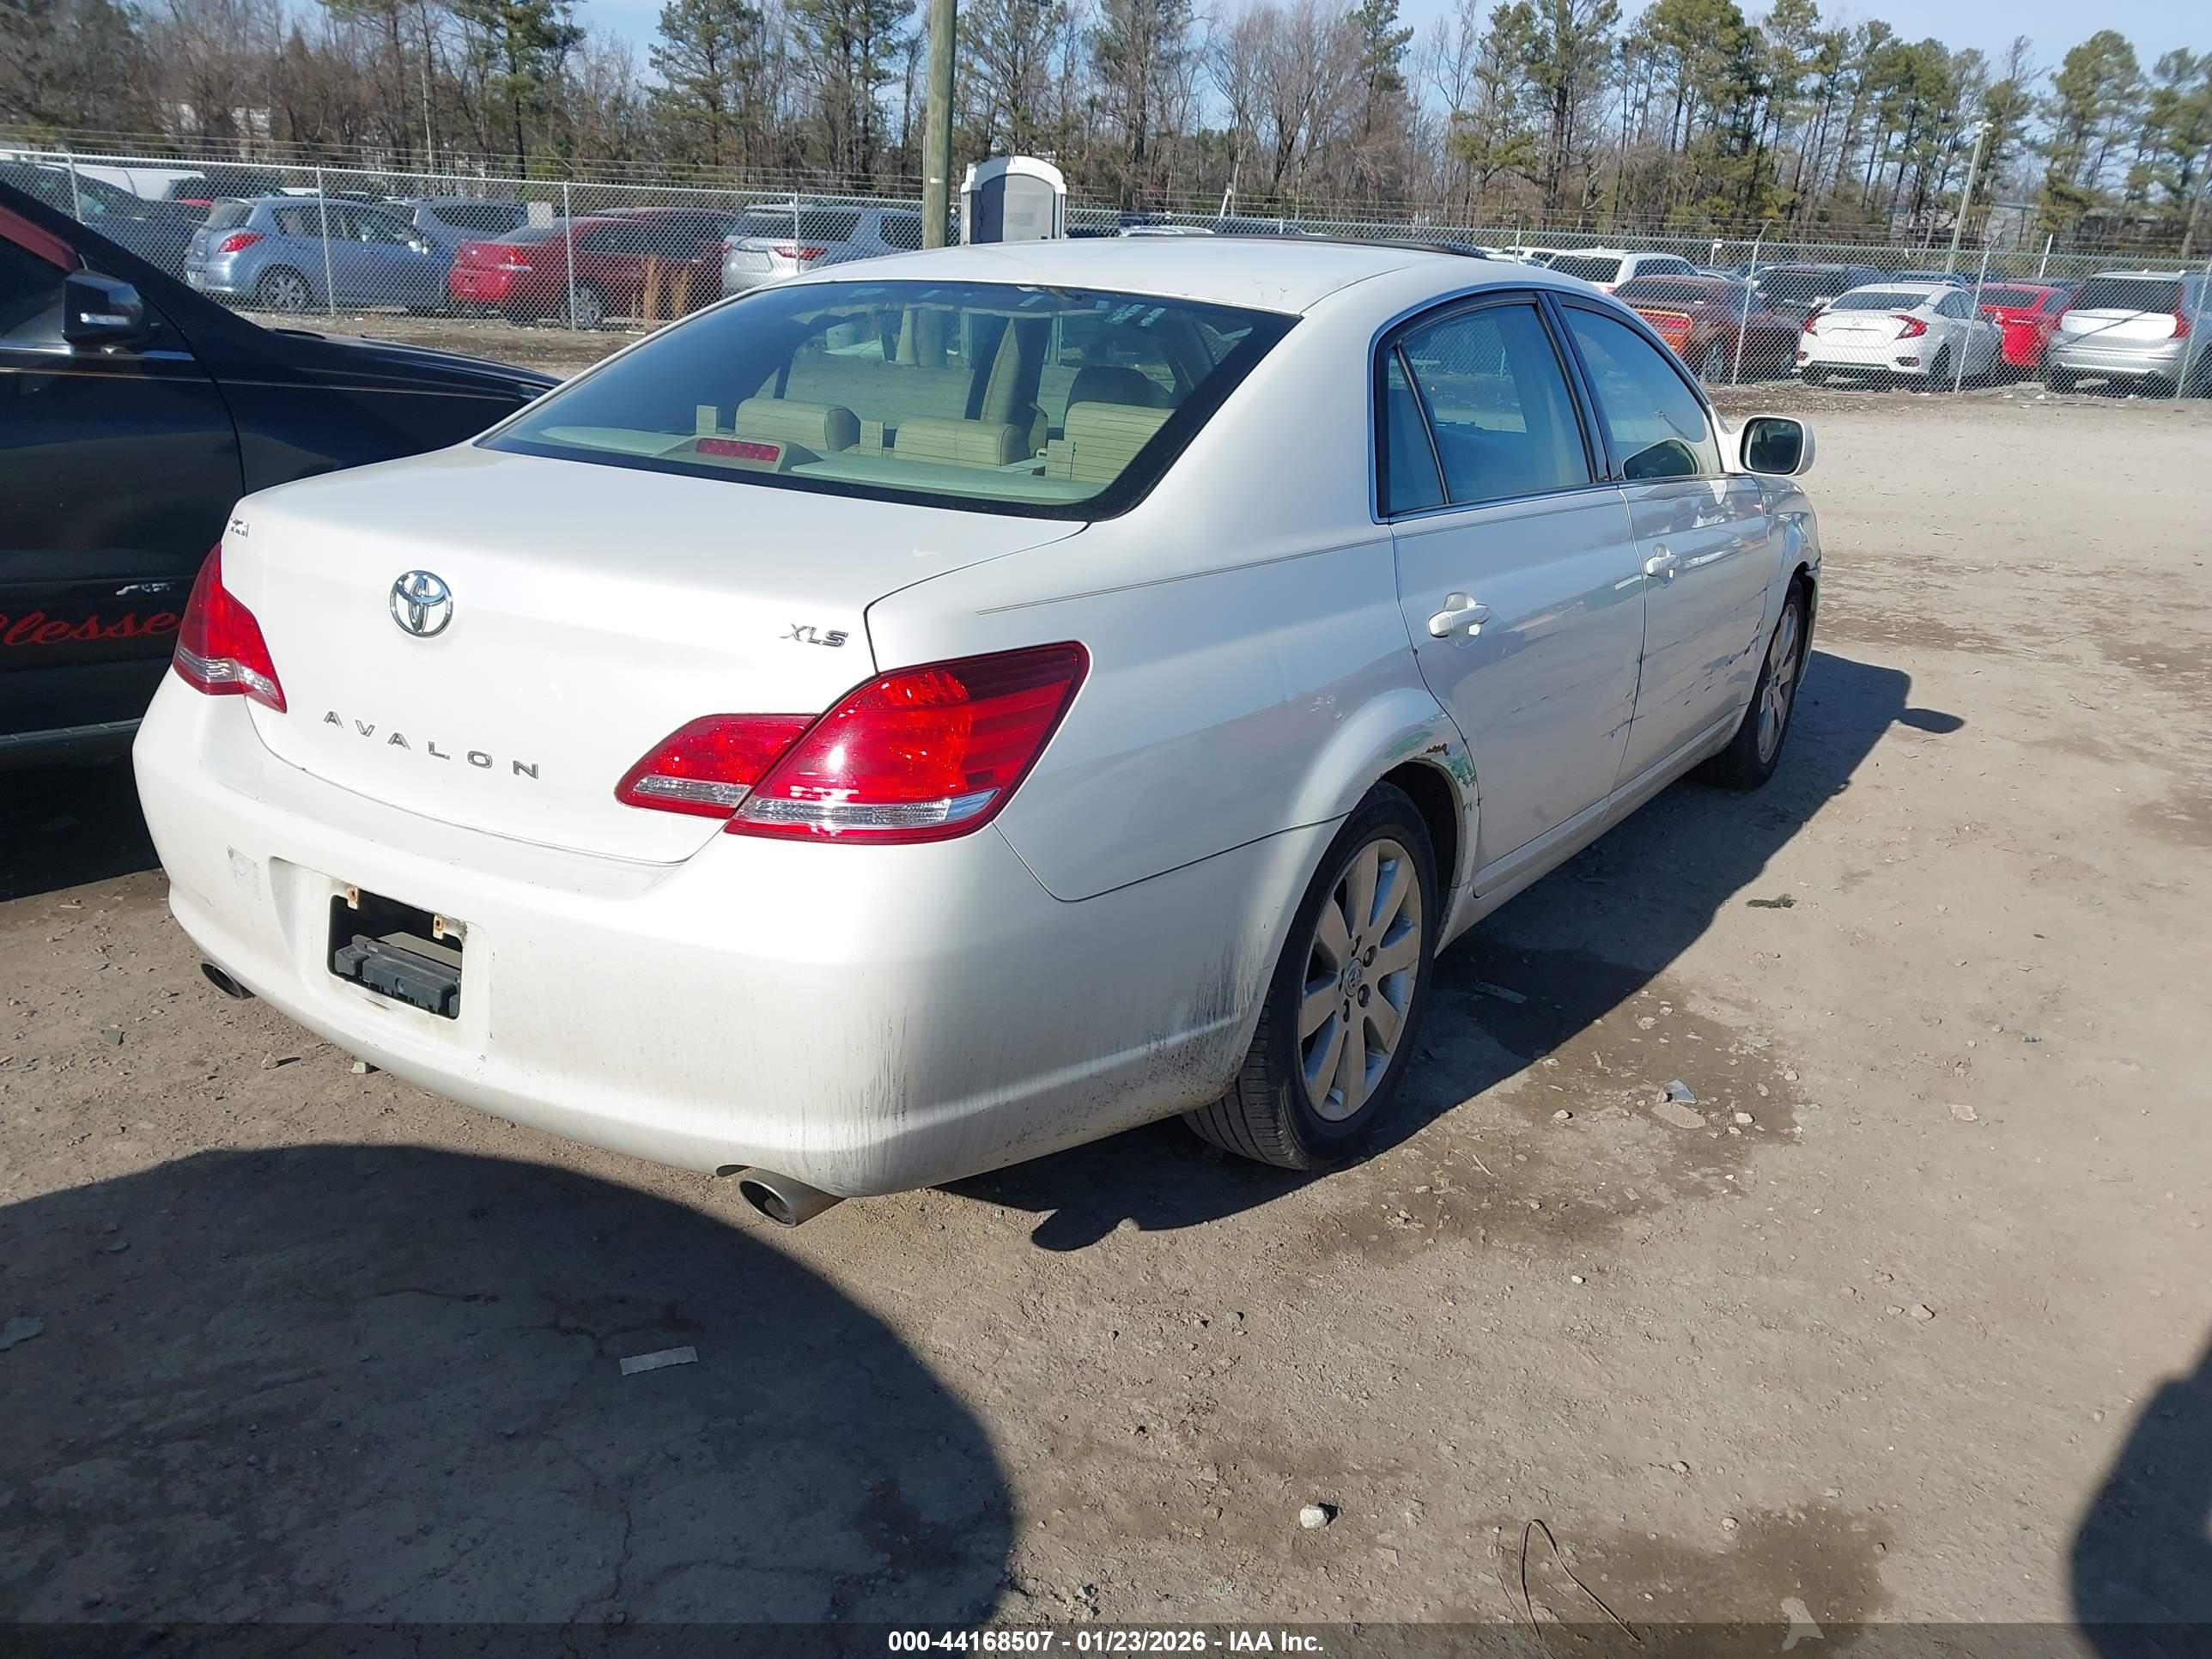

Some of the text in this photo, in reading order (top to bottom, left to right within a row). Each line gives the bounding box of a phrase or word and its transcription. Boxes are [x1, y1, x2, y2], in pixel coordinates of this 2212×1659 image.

[0, 611, 181, 646] lesse
[779, 623, 848, 648] XLS
[323, 710, 539, 780] AVALON
